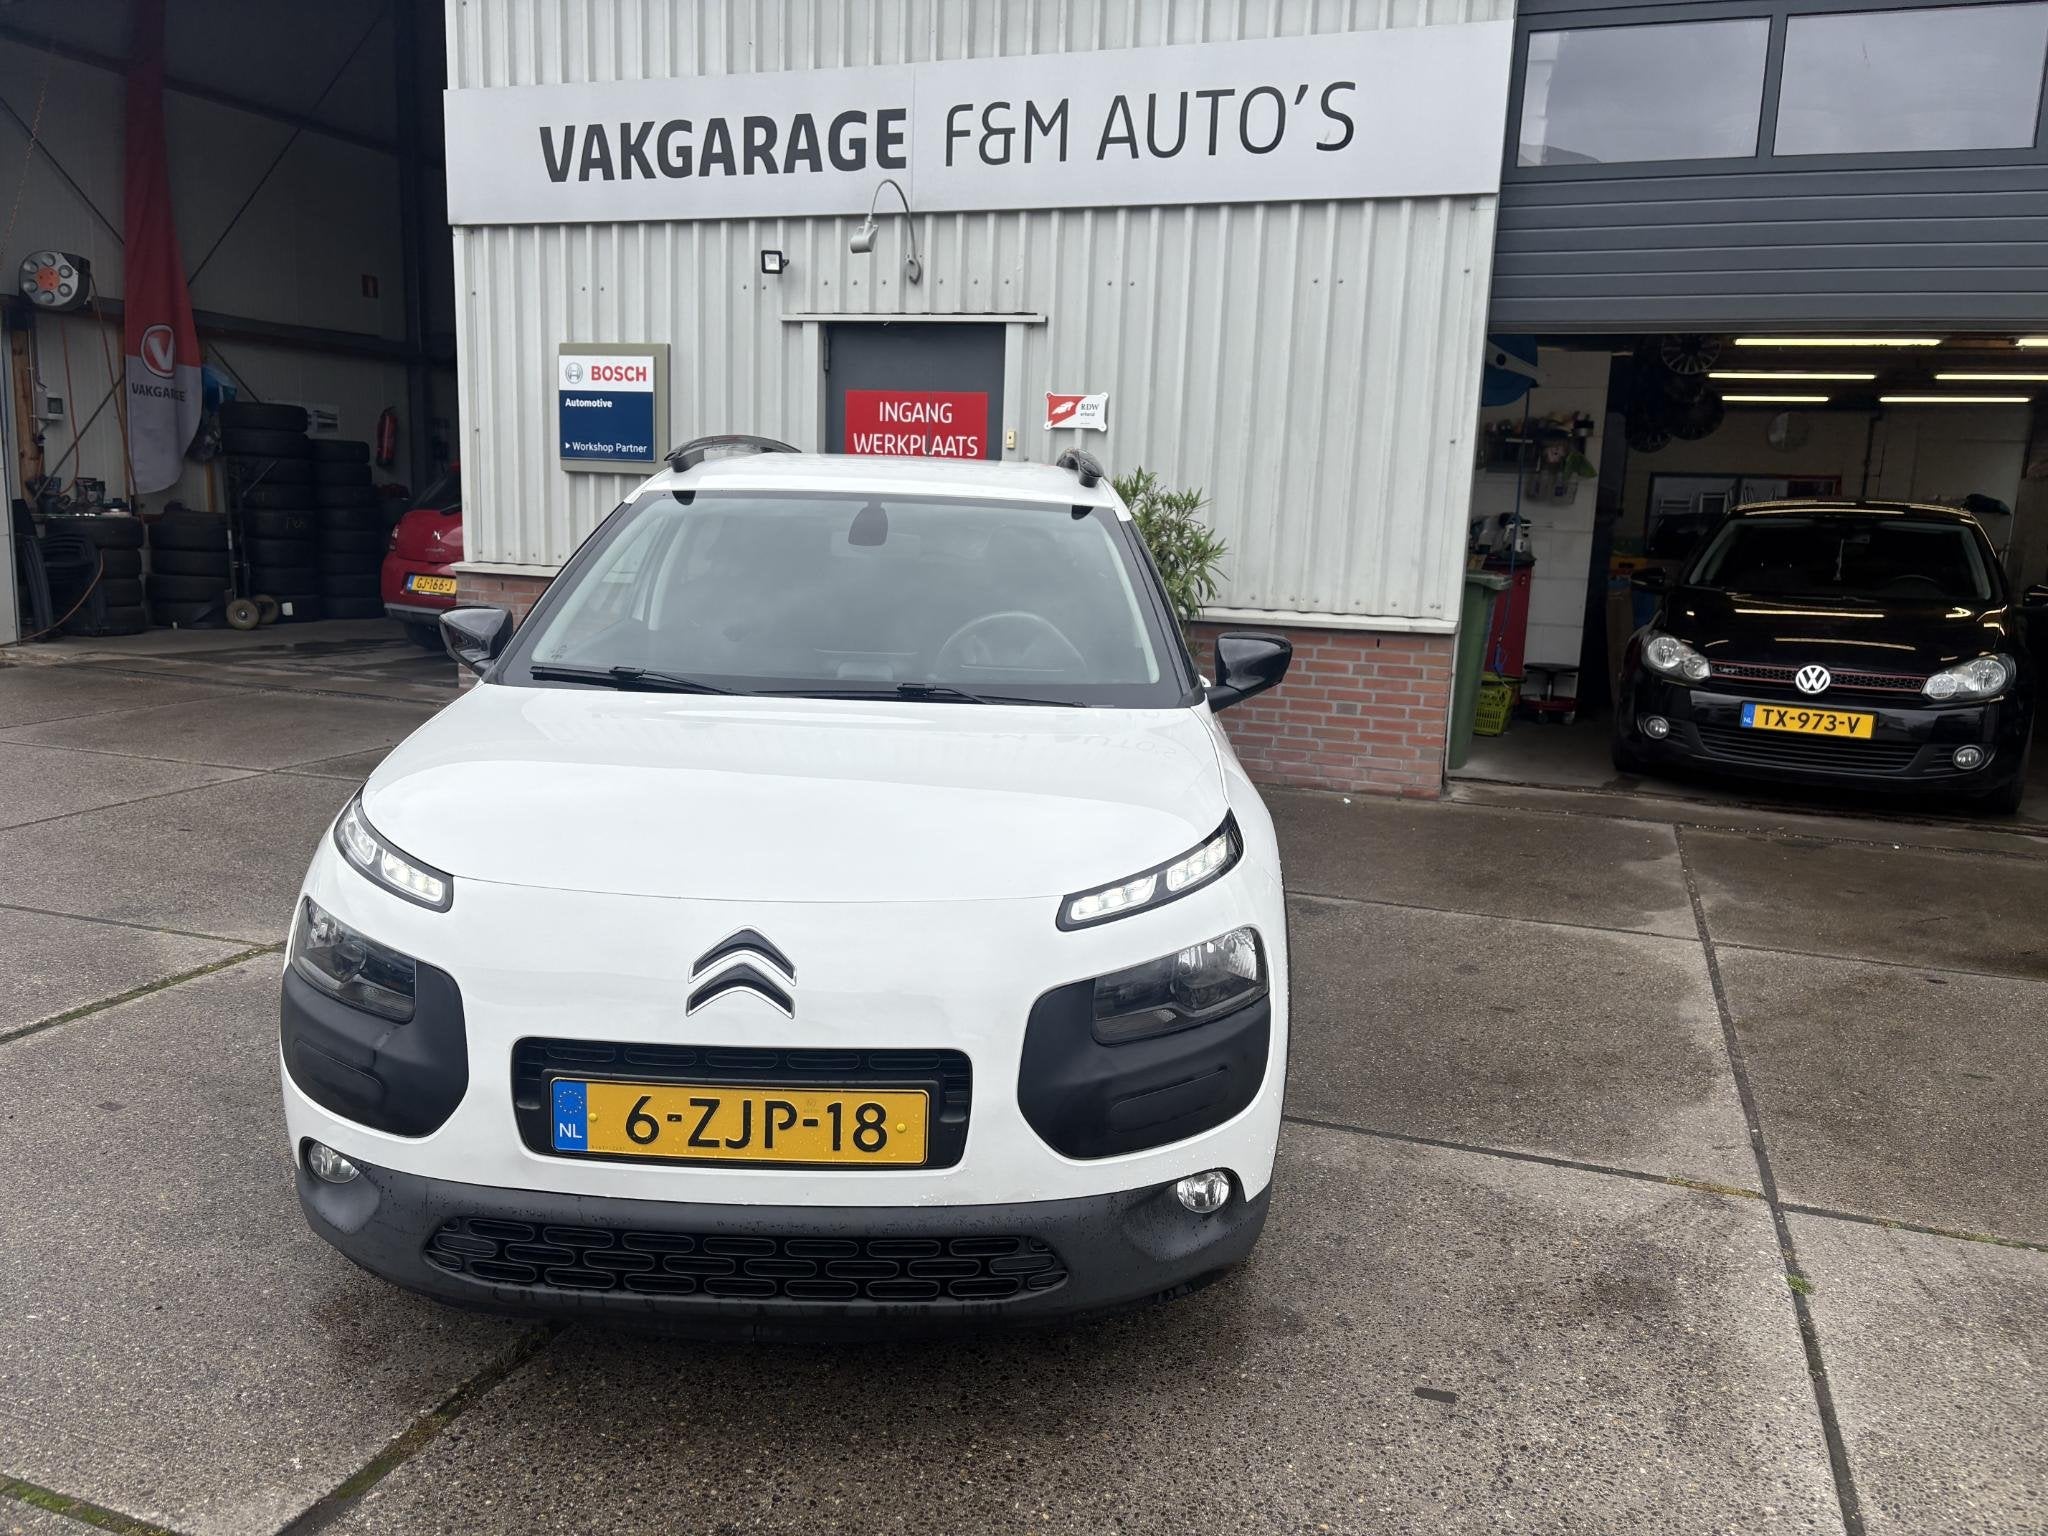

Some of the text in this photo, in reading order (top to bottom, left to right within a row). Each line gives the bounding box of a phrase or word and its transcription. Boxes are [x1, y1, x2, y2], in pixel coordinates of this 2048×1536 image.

[539, 81, 1356, 182] VAKGARAGE F&M AUTO'S
[591, 365, 647, 382] BOSCH
[565, 398, 613, 408] Automotive
[879, 401, 953, 424] INGANG
[1081, 403, 1099, 411] RDW
[572, 442, 647, 453] Workshop Partner
[853, 433, 978, 457] WERKPLAATS
[1762, 708, 1861, 734] TX-973-V
[559, 1095, 888, 1152] NL 6-ZJP-18
